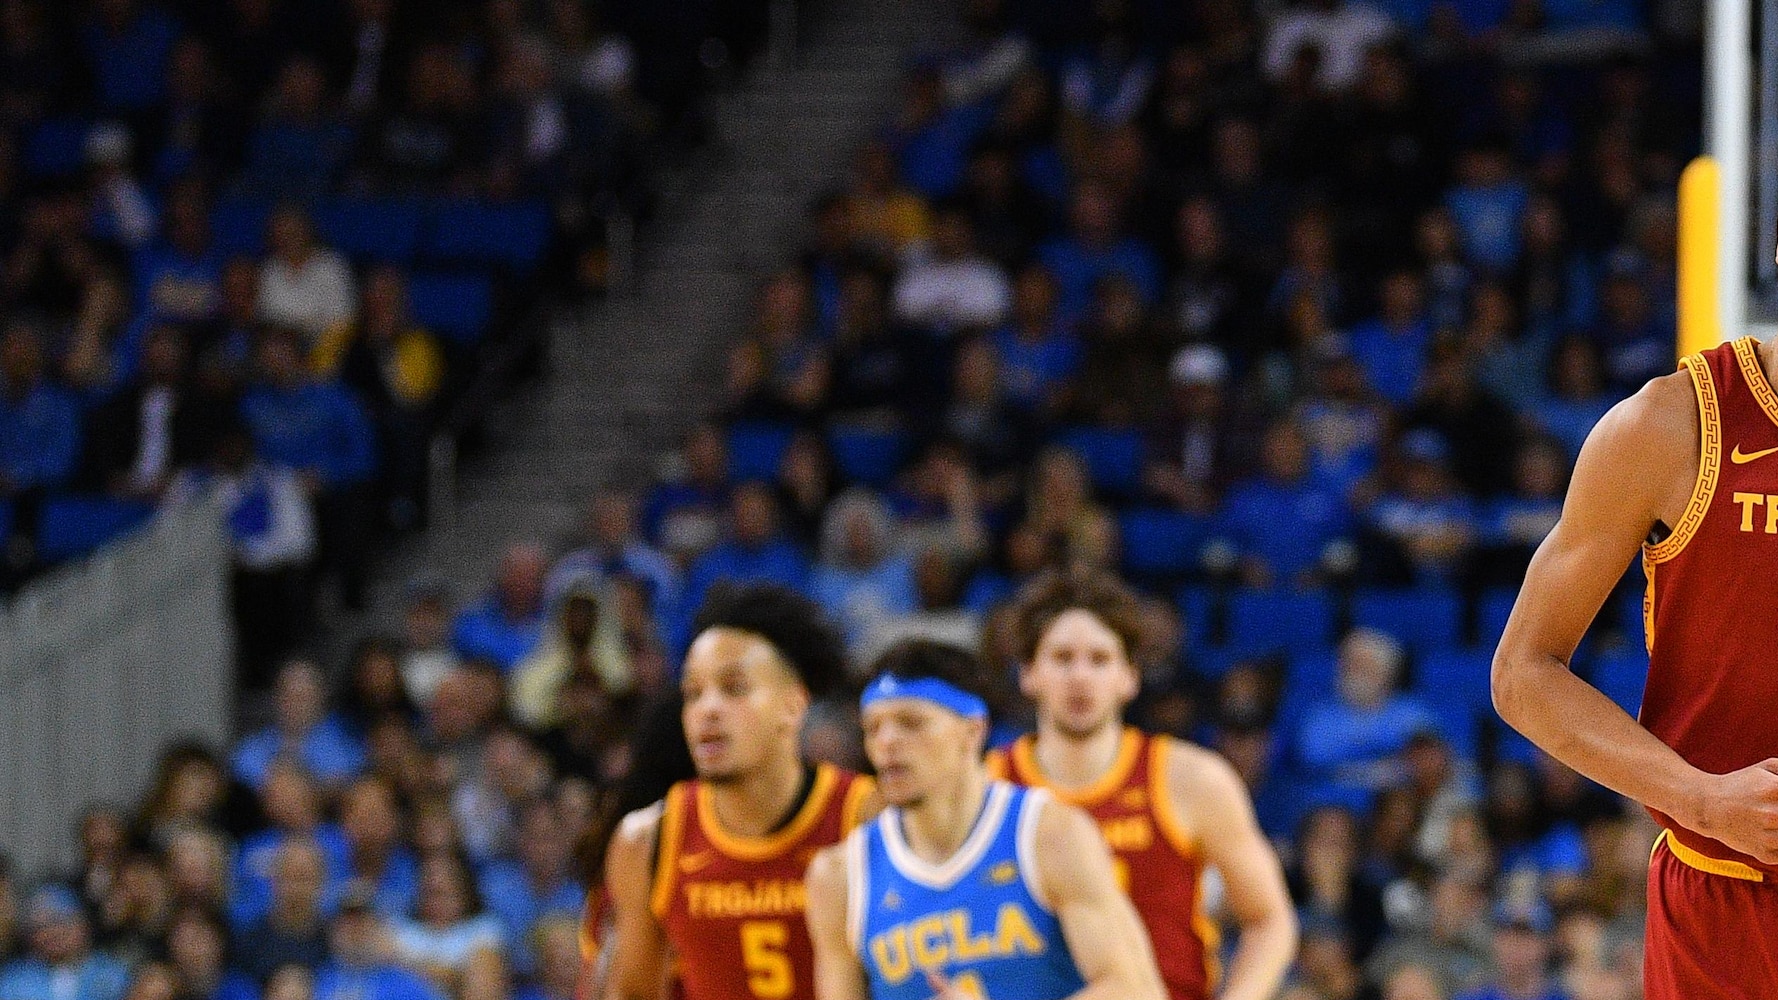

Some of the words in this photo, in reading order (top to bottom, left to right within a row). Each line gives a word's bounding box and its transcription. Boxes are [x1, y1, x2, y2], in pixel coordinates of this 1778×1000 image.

[686, 880, 806, 916] TROJAN
[740, 922, 795, 1000] 5
[870, 904, 1047, 985] UCLA
